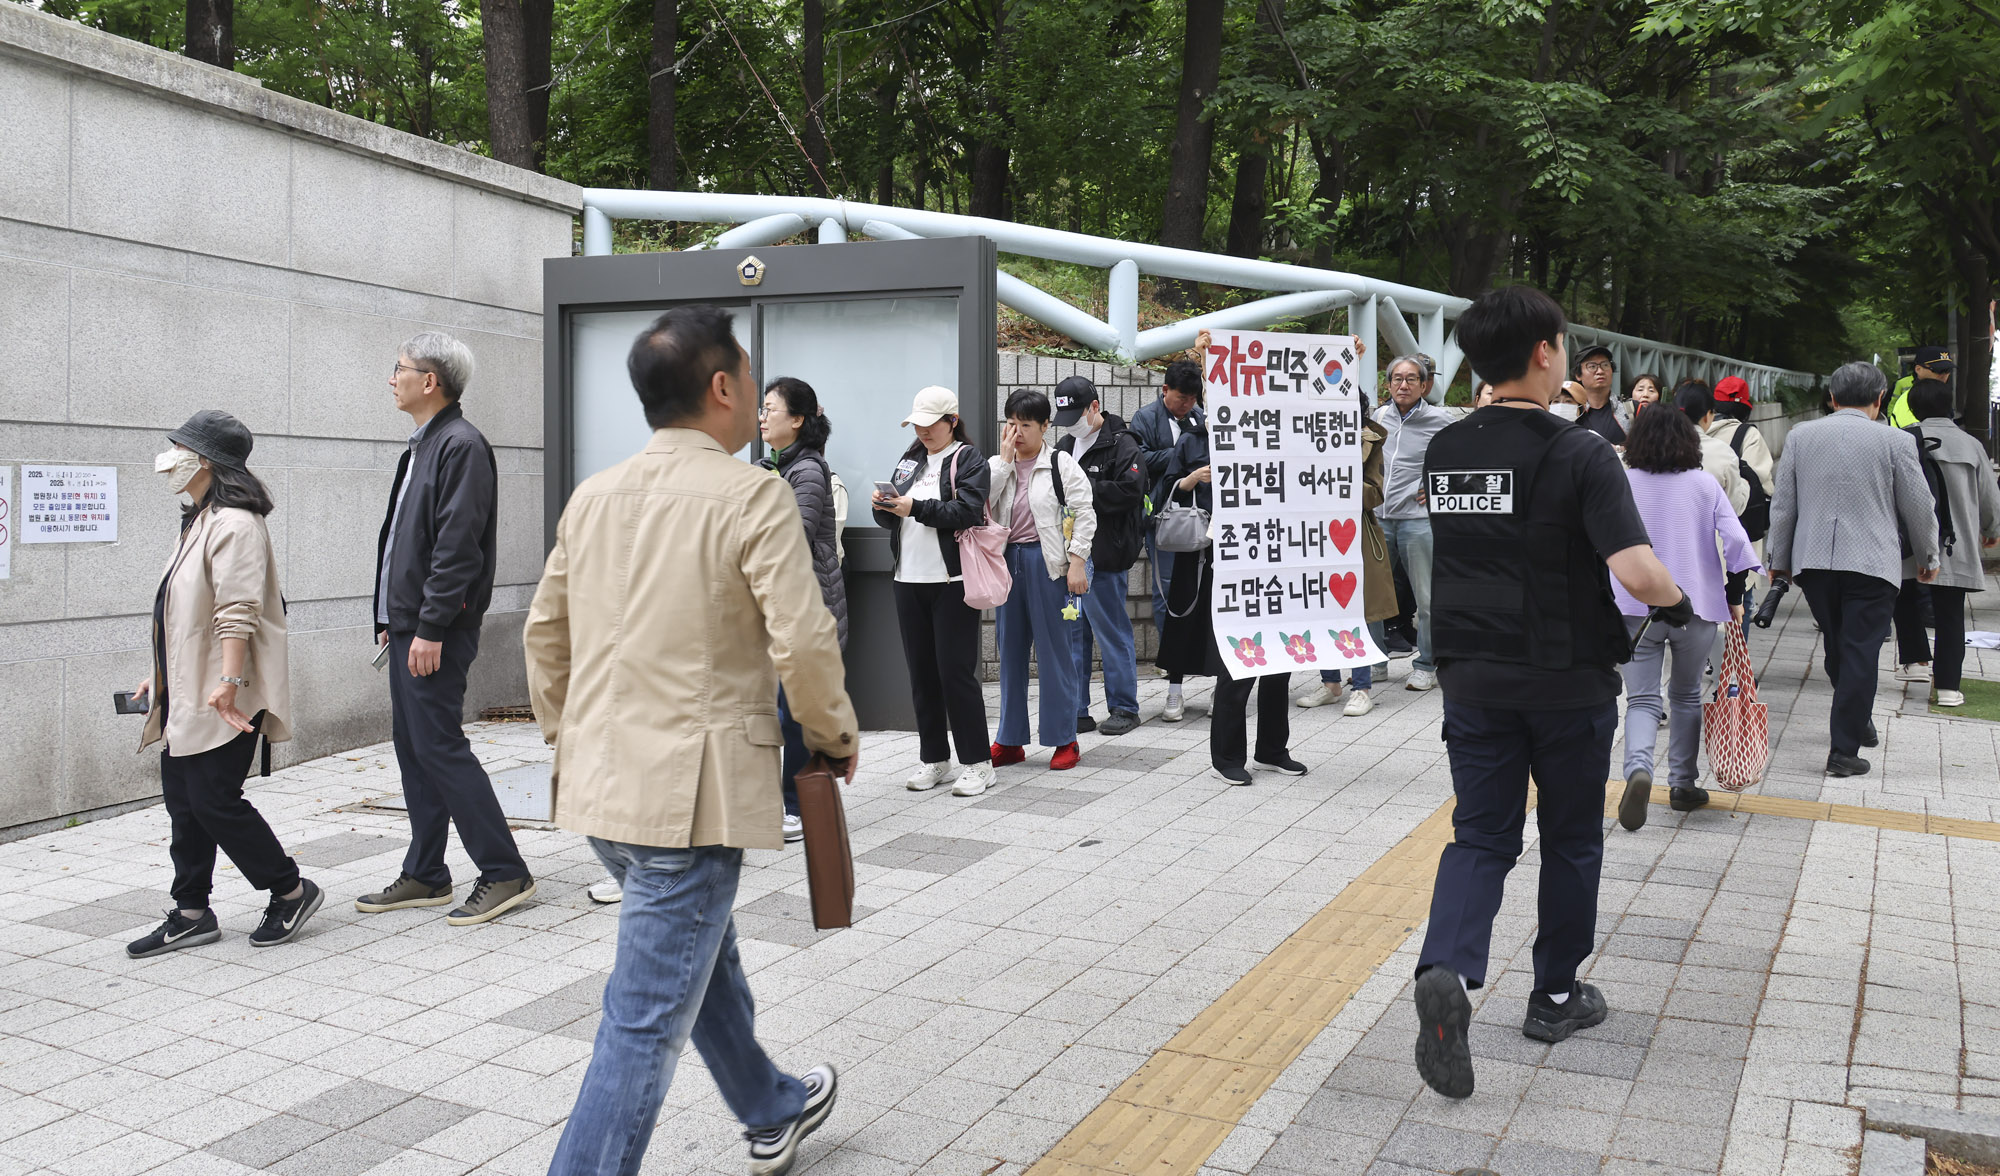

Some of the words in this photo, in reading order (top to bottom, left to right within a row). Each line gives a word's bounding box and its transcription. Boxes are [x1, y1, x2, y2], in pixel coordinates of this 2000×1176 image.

[1207, 336, 1309, 397] 자유민주
[1212, 405, 1281, 451] 윤석열
[1292, 410, 1358, 453] 대통령님
[1217, 461, 1286, 508] 김건희
[1298, 464, 1353, 499] 여사님
[1437, 496, 1502, 511] POLICE
[28, 514, 41, 522] 법원
[1219, 518, 1328, 563] 존경합니다
[1217, 571, 1328, 618] 고맙습니다
